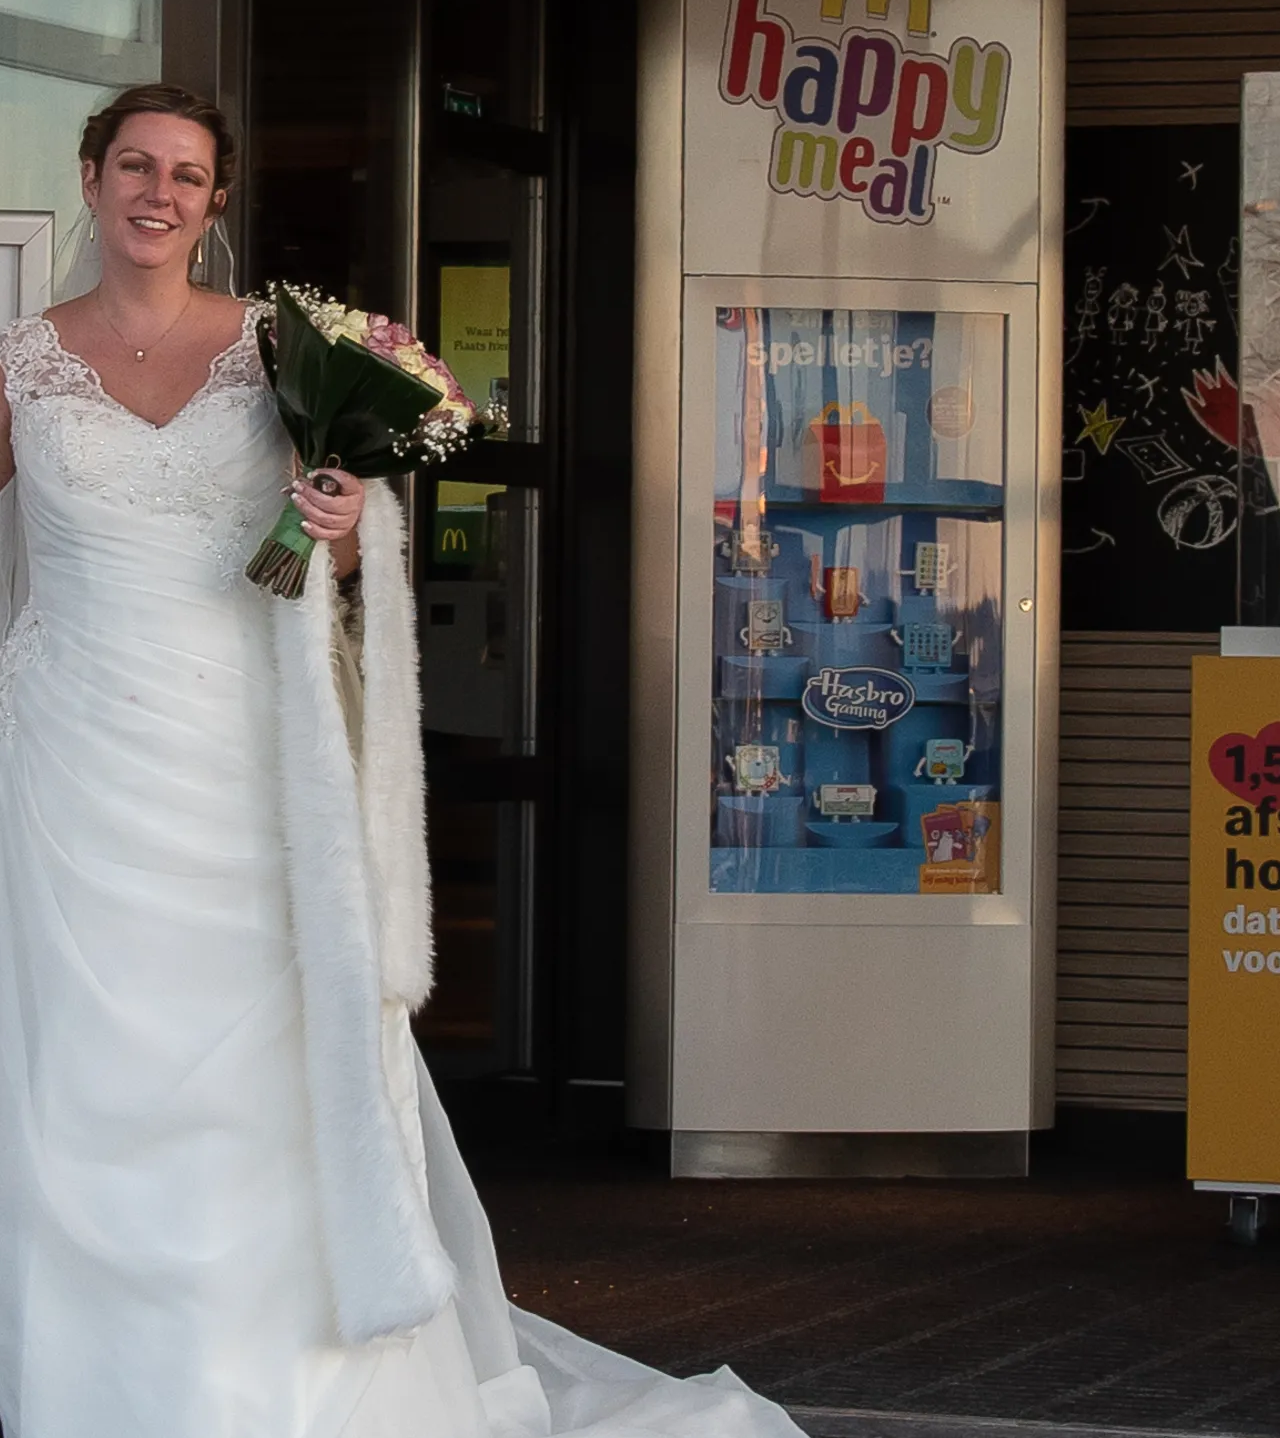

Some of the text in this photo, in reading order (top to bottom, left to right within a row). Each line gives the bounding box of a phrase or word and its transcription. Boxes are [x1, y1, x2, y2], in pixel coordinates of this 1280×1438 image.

[776, 130, 931, 217] meal
[747, 332, 934, 377] spelletje?
[810, 671, 905, 706] Hasbro
[825, 694, 888, 725] Gaming
